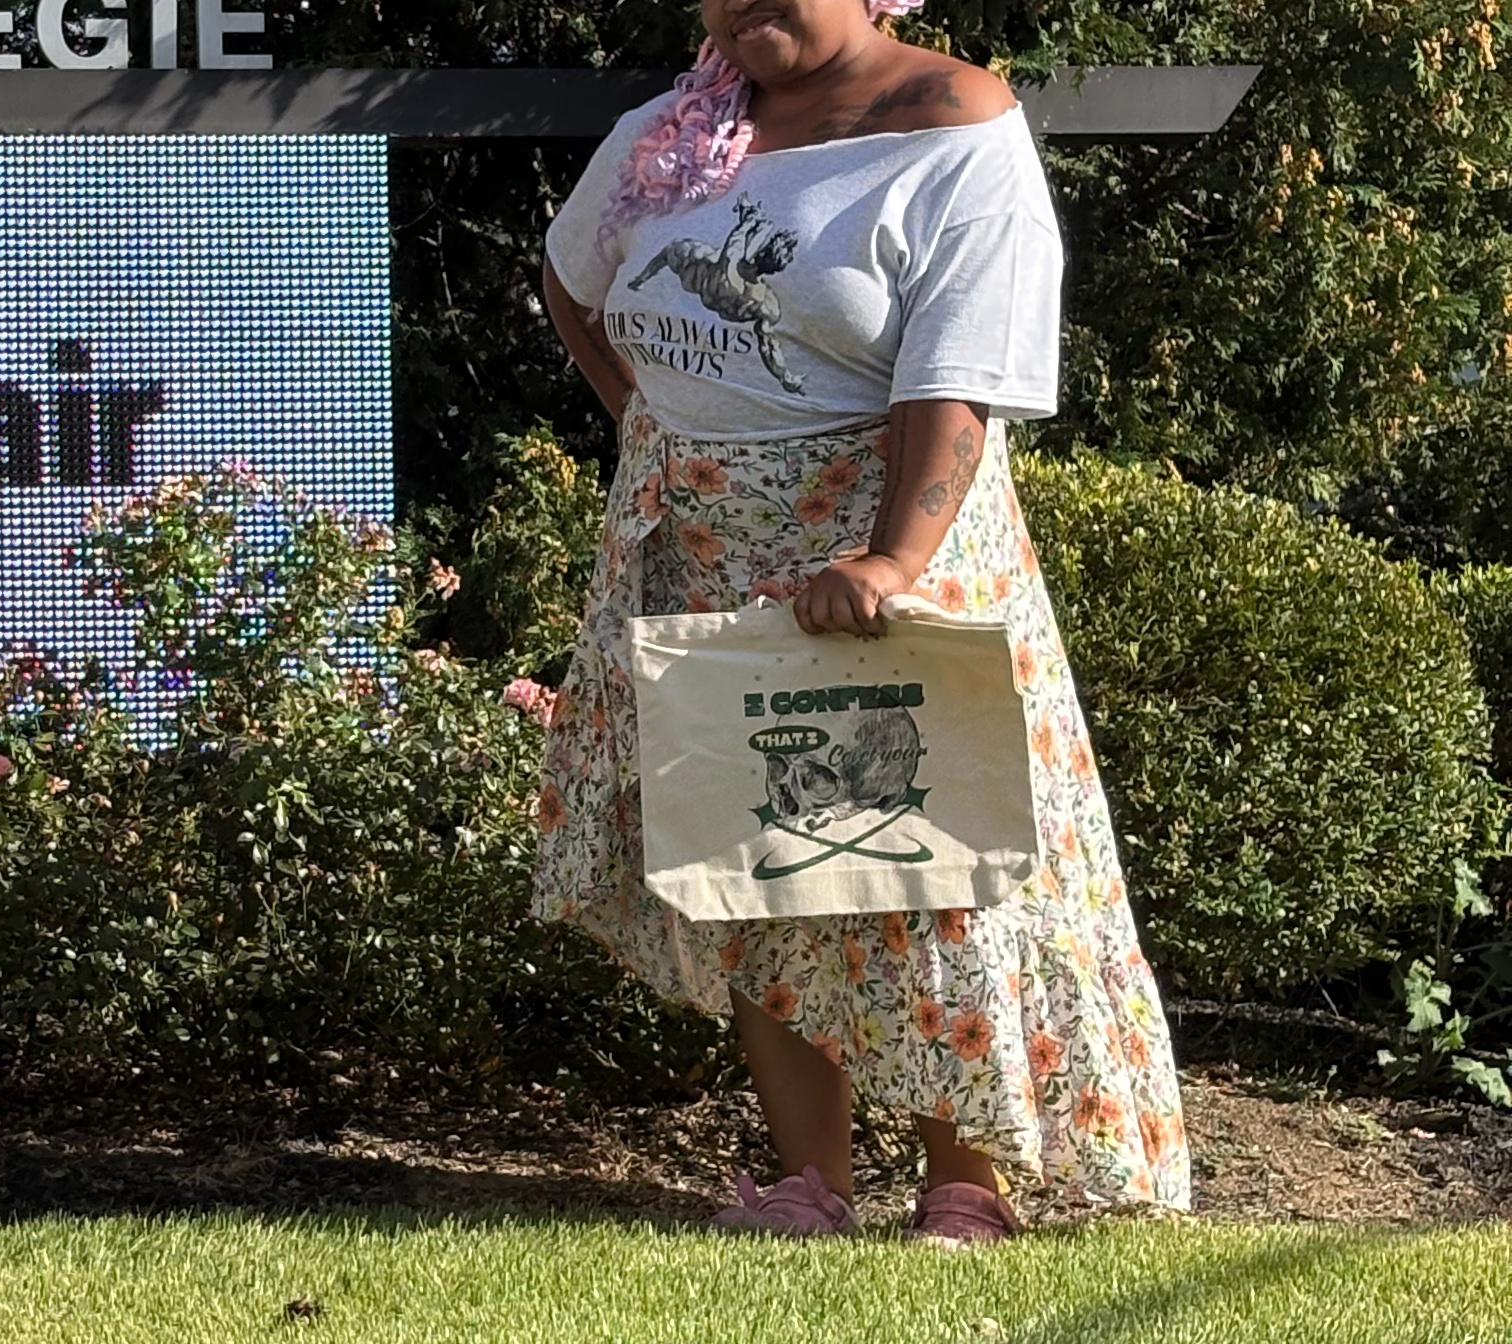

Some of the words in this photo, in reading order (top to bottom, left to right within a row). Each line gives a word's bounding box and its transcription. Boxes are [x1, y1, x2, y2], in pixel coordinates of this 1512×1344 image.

[650, 315, 754, 355] ALWAYS
[744, 692, 765, 717] I
[770, 683, 925, 715] CONFESS
[755, 732, 803, 748] THAT
[806, 731, 819, 745] I
